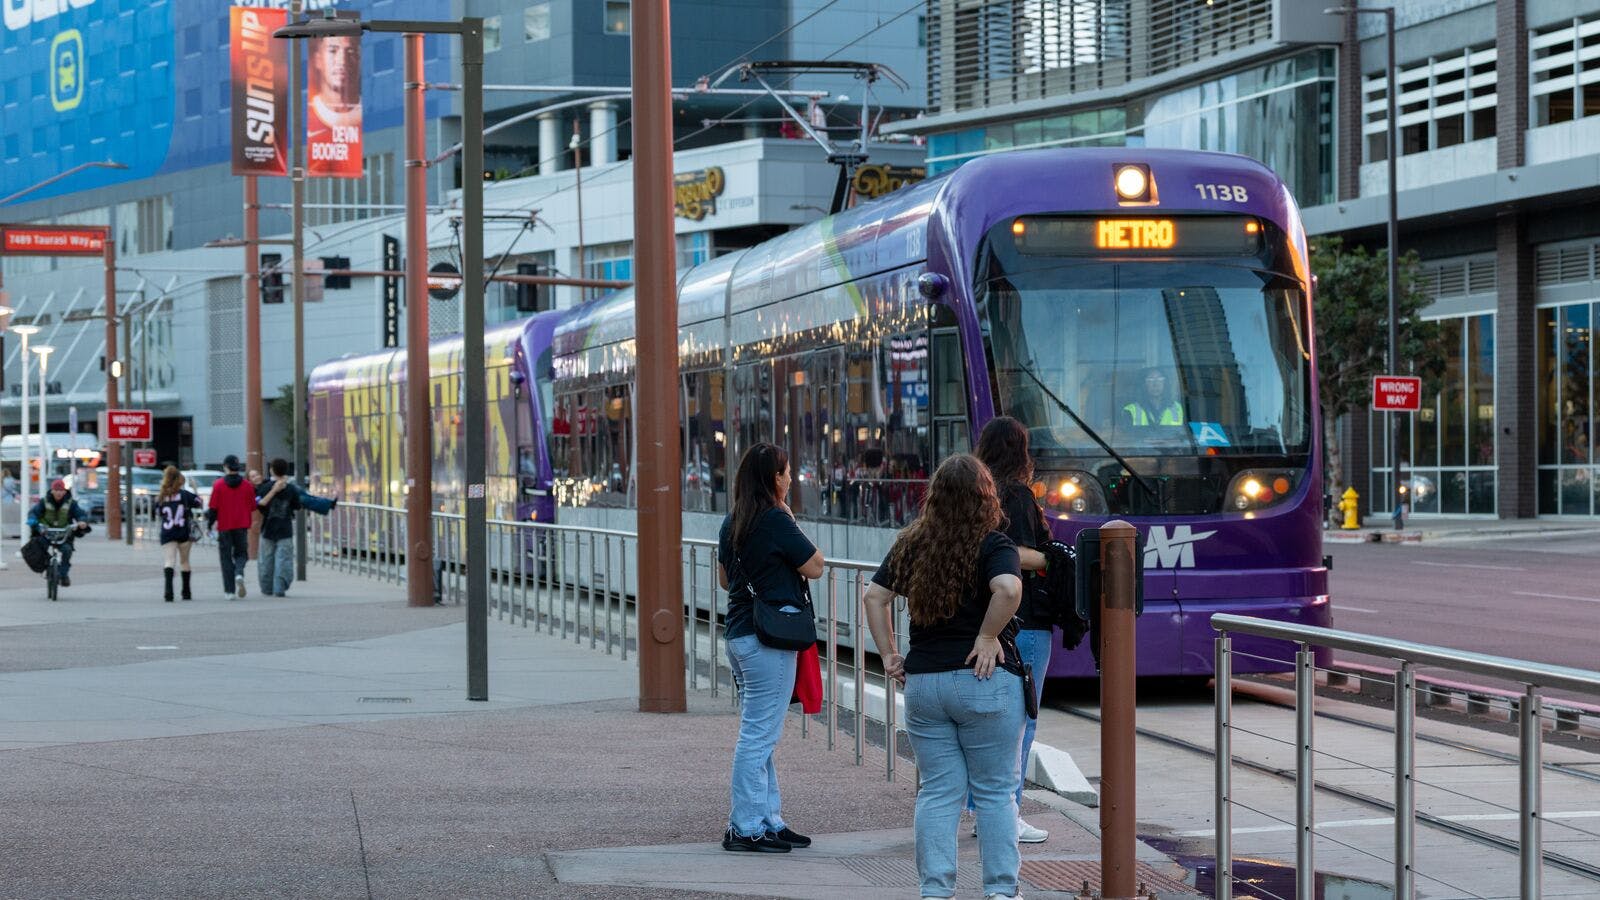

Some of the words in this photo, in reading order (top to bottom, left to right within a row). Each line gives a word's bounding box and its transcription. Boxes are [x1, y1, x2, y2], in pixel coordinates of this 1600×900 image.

[241, 10, 269, 54] UP
[312, 142, 348, 160] BOOKER
[1195, 183, 1249, 203] 113B
[70, 235, 90, 248] Way
[1098, 218, 1175, 249] METRO
[1380, 381, 1415, 393] WRONG
[1386, 394, 1408, 405] WAY
[112, 414, 146, 425] WRONG
[118, 426, 140, 437] WAY
[1198, 421, 1227, 444] A
[162, 504, 186, 530] 34
